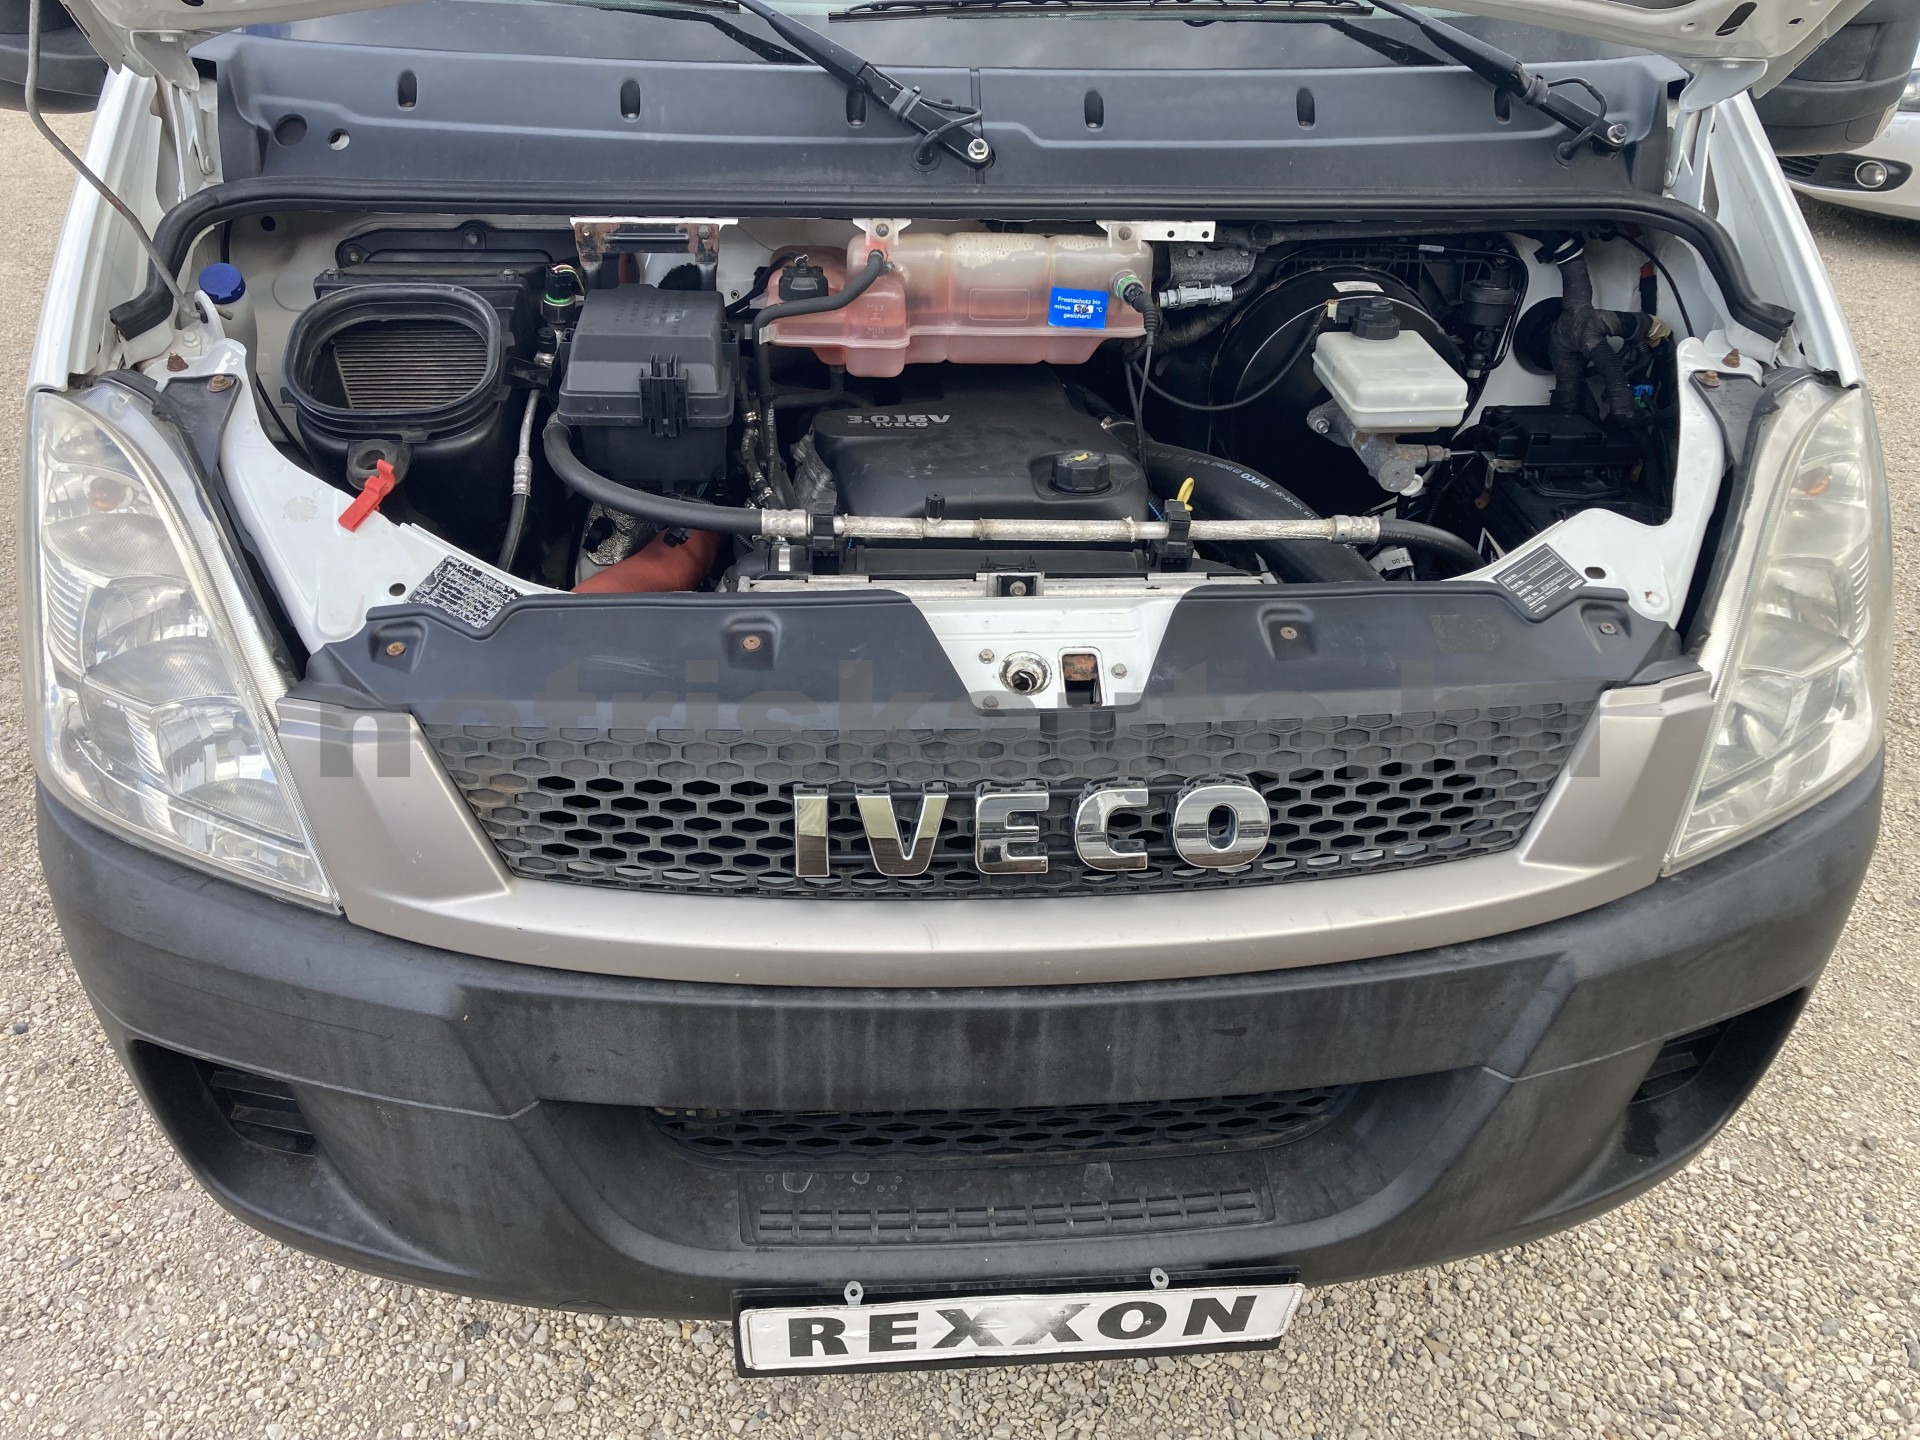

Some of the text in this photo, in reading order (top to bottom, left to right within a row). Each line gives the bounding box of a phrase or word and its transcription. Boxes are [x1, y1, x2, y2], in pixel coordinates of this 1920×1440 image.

[1058, 296, 1091, 304] Frostschutz
[875, 421, 929, 429] IVECO
[1240, 472, 1270, 490] IVECO
[1568, 579, 1584, 590] IVECO
[793, 775, 1271, 878] IVECO
[788, 1295, 1258, 1358] REXXON
